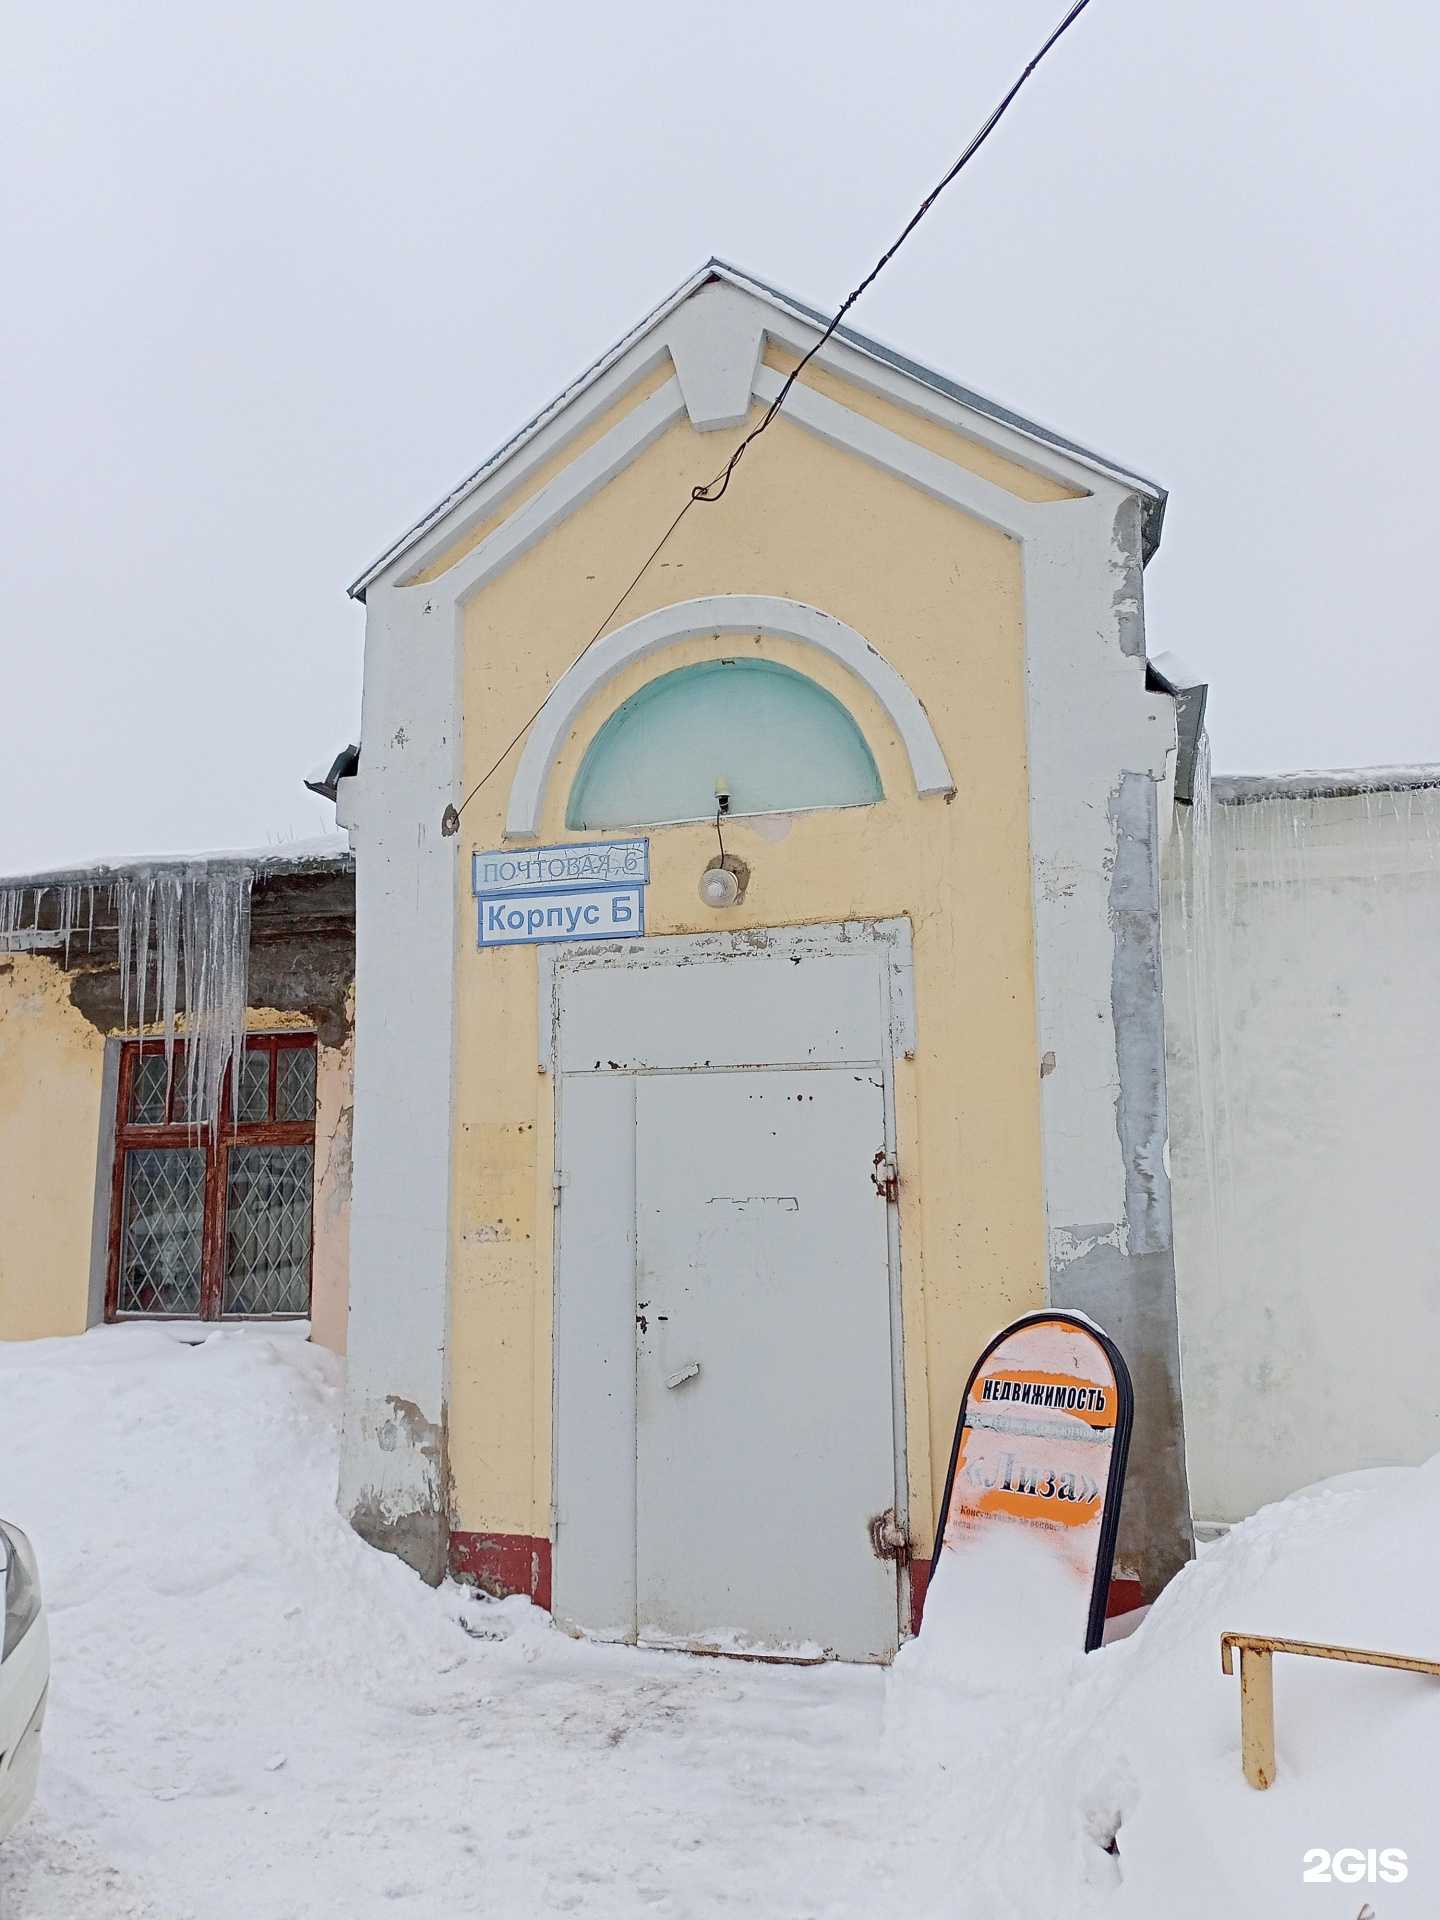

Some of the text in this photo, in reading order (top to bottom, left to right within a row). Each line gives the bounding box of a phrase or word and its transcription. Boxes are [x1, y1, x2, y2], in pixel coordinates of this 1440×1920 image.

[624, 851, 638, 871] 6
[488, 896, 632, 934] Корпус Б
[982, 1379, 1106, 1412] НЕДВИЖИМОСТЬ
